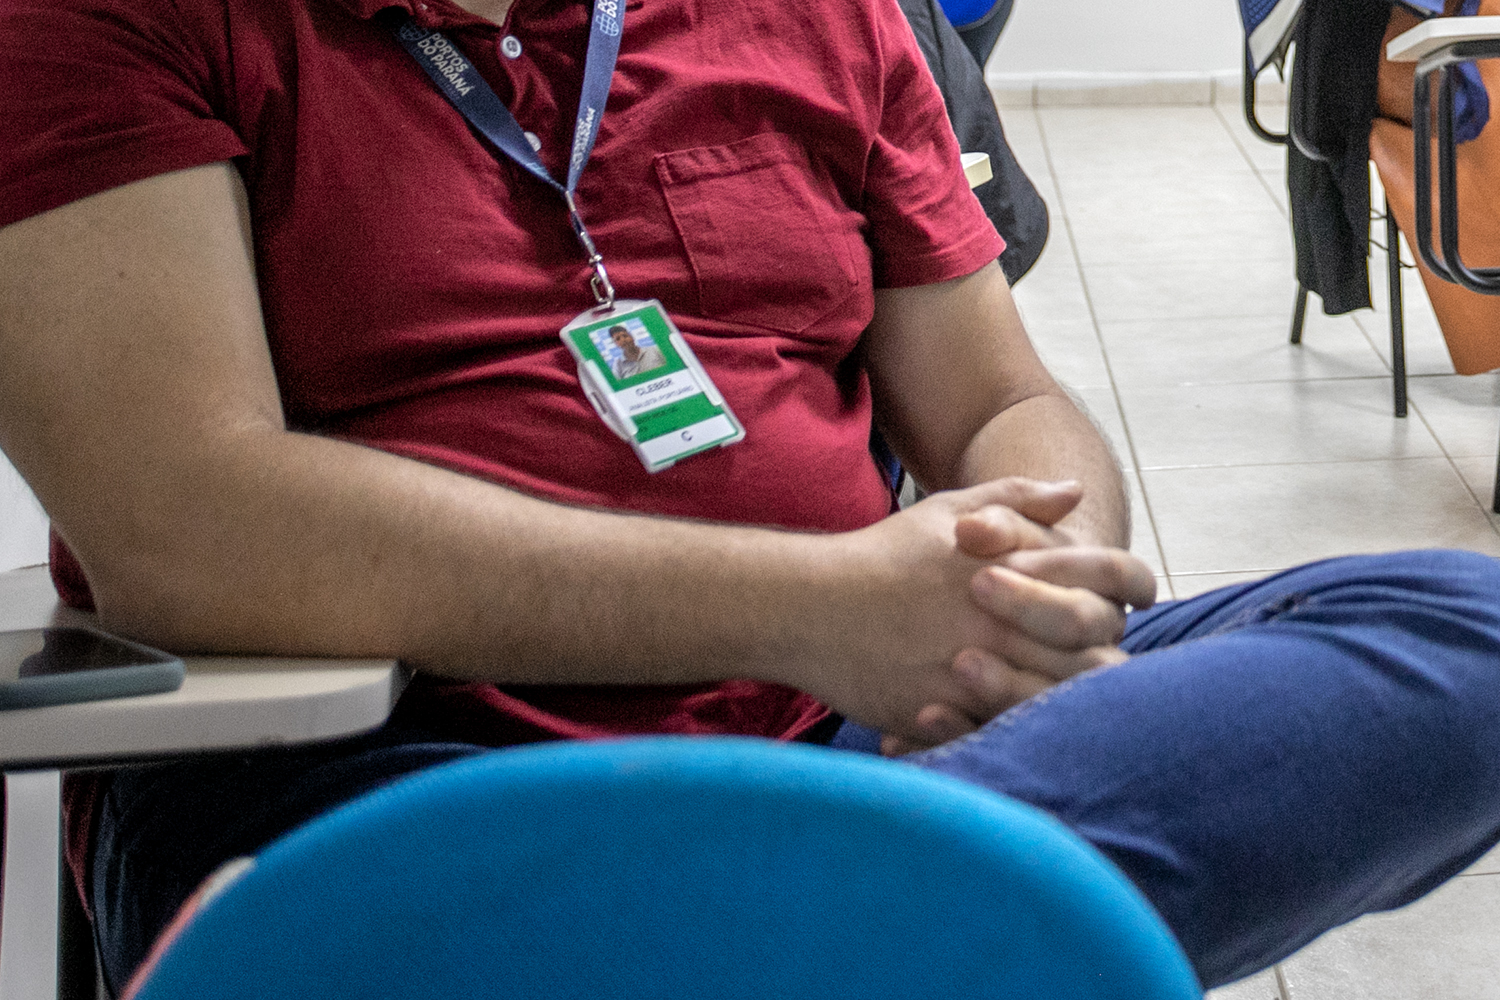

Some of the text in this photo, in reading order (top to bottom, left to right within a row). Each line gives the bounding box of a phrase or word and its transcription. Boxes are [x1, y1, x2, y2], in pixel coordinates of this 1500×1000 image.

[606, 1, 618, 18] DO
[428, 32, 469, 73] PORTOS
[417, 39, 476, 97] DO PARANÁ
[681, 430, 693, 442] C
